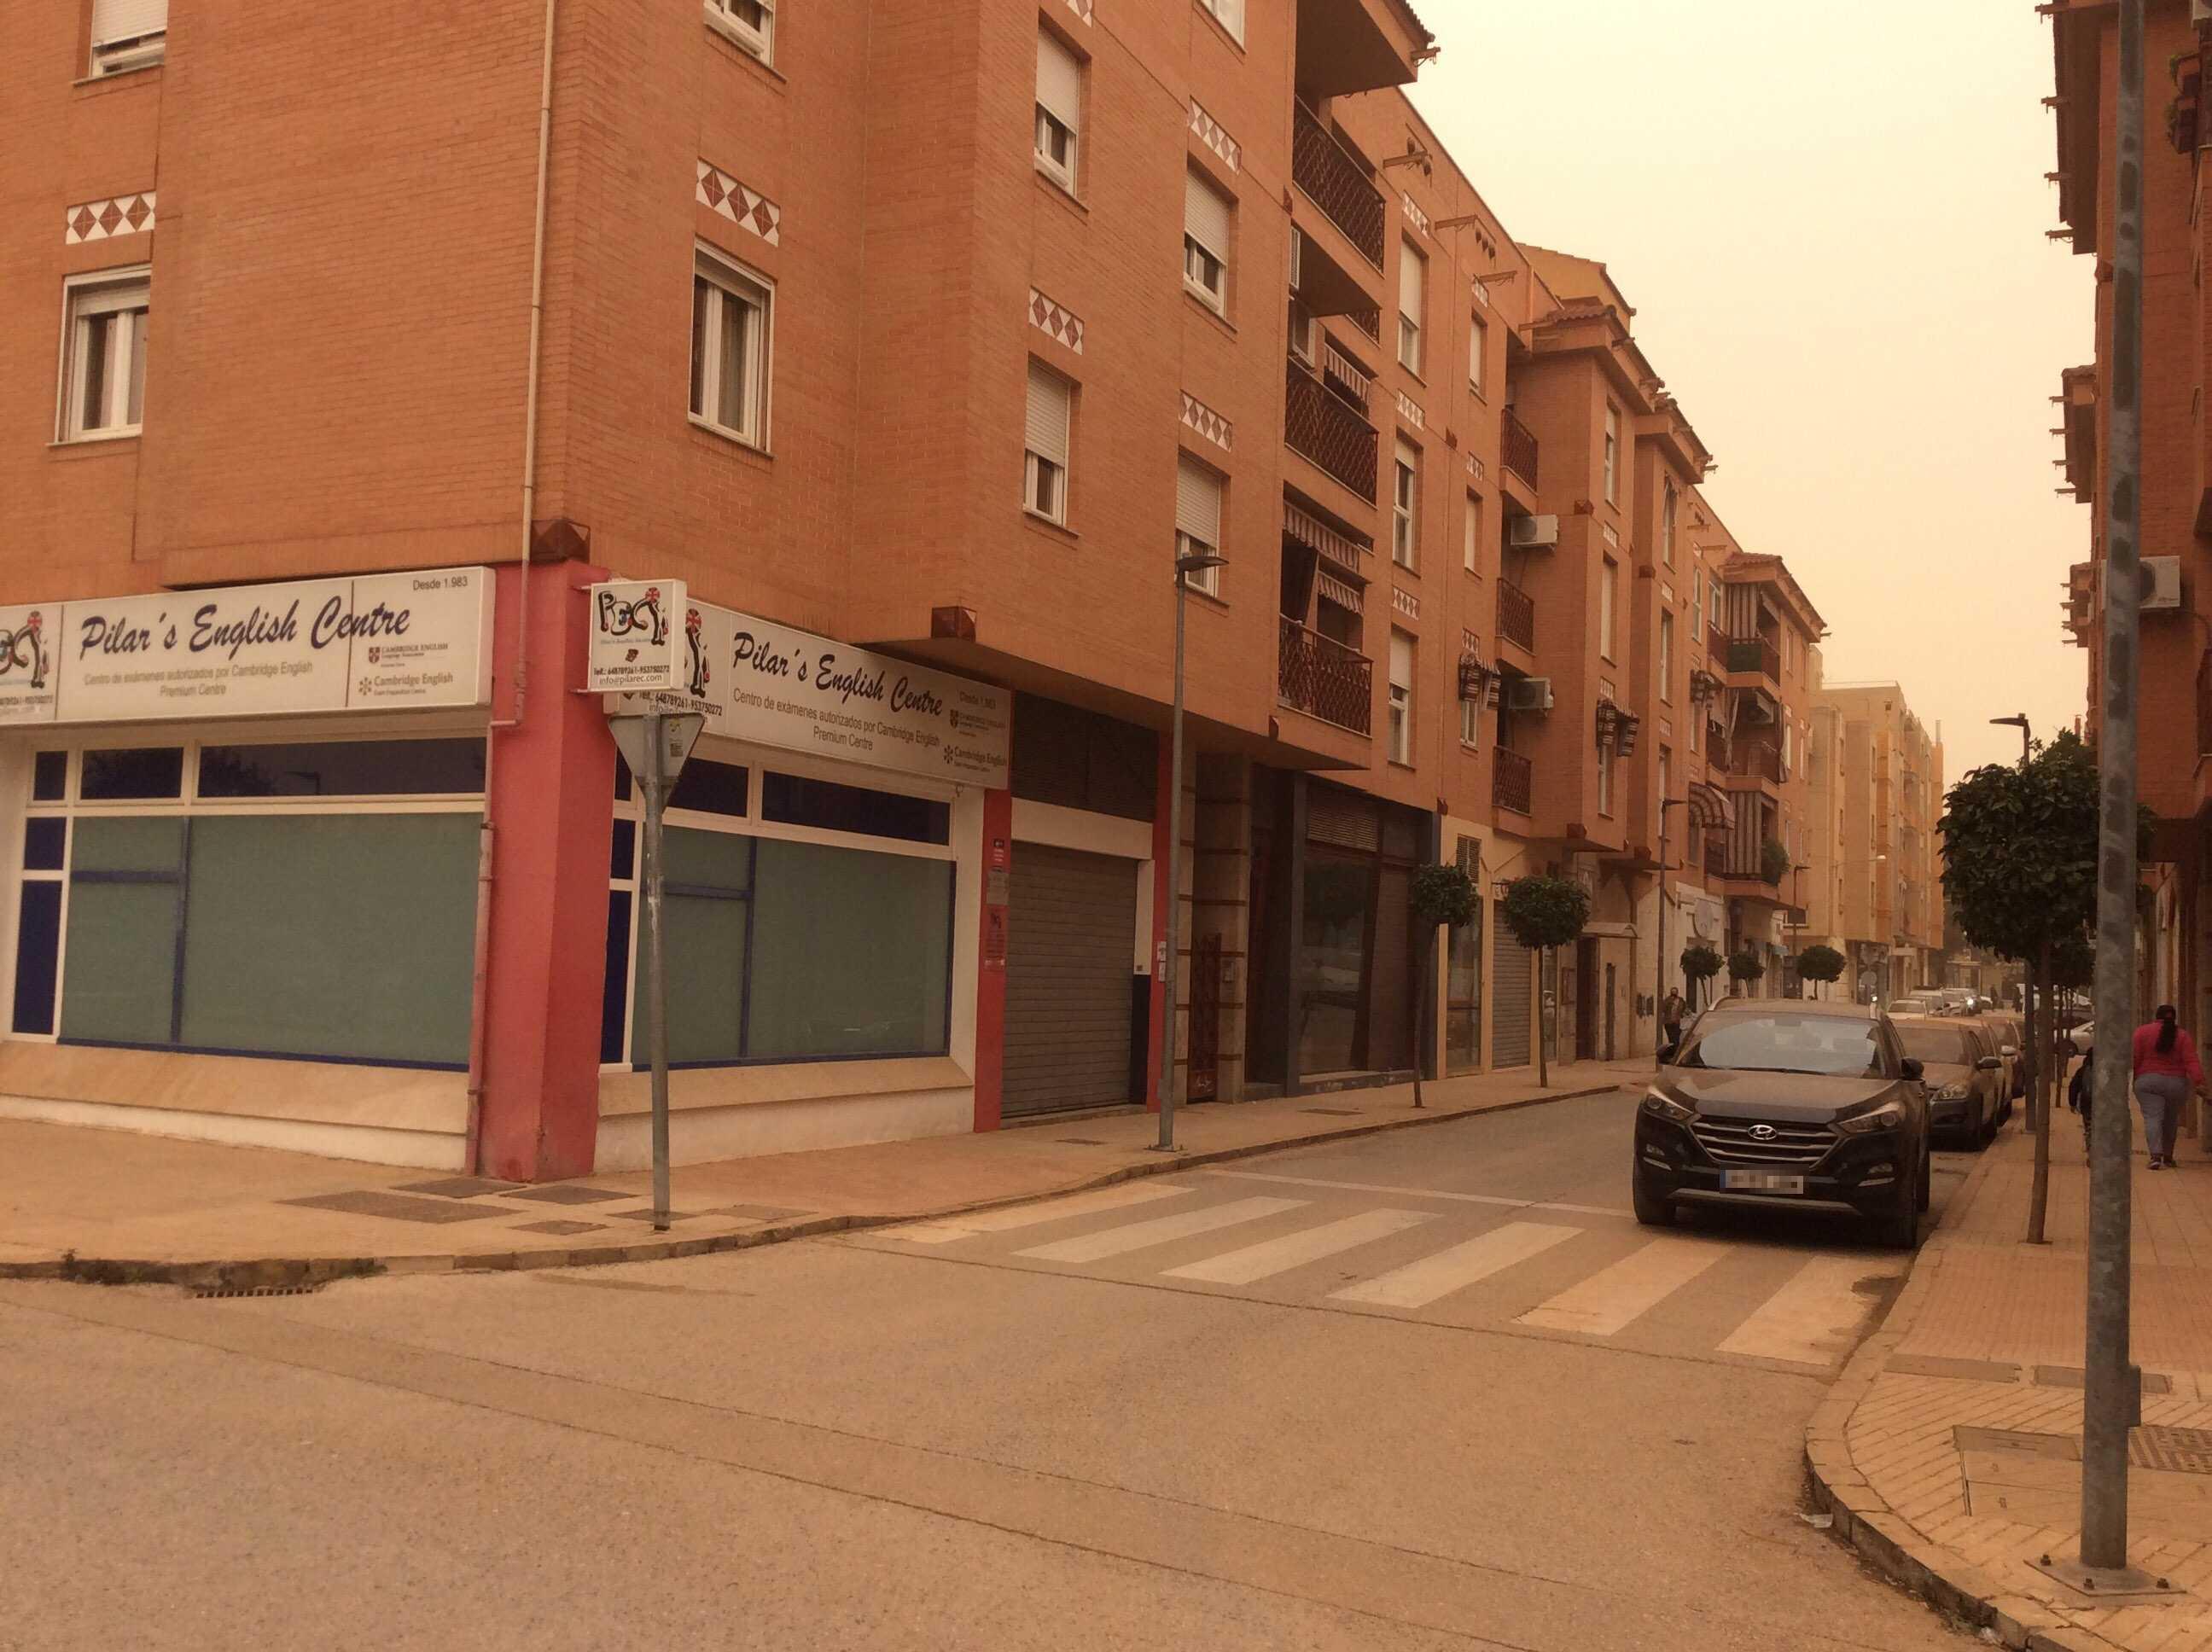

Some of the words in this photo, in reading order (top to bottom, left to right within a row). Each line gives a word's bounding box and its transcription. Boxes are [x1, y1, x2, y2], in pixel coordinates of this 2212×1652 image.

[413, 579, 441, 590] Desde
[445, 576, 468, 588] 1.983
[189, 599, 298, 660] English
[311, 596, 410, 649] Centre
[215, 667, 229, 679] por
[231, 664, 279, 678] Cambridge
[281, 660, 312, 676] English
[374, 672, 420, 686] Cambridge
[422, 672, 453, 685] English
[160, 686, 196, 697] Premium
[198, 683, 226, 696] Centre
[816, 654, 886, 704] English
[890, 676, 943, 716] Centre
[733, 688, 763, 708] Centro
[764, 695, 775, 711] de
[819, 709, 862, 730] autorizados
[864, 720, 876, 736] por
[876, 721, 915, 744] Cambridge
[916, 730, 940, 747] English
[813, 725, 847, 746] Premium
